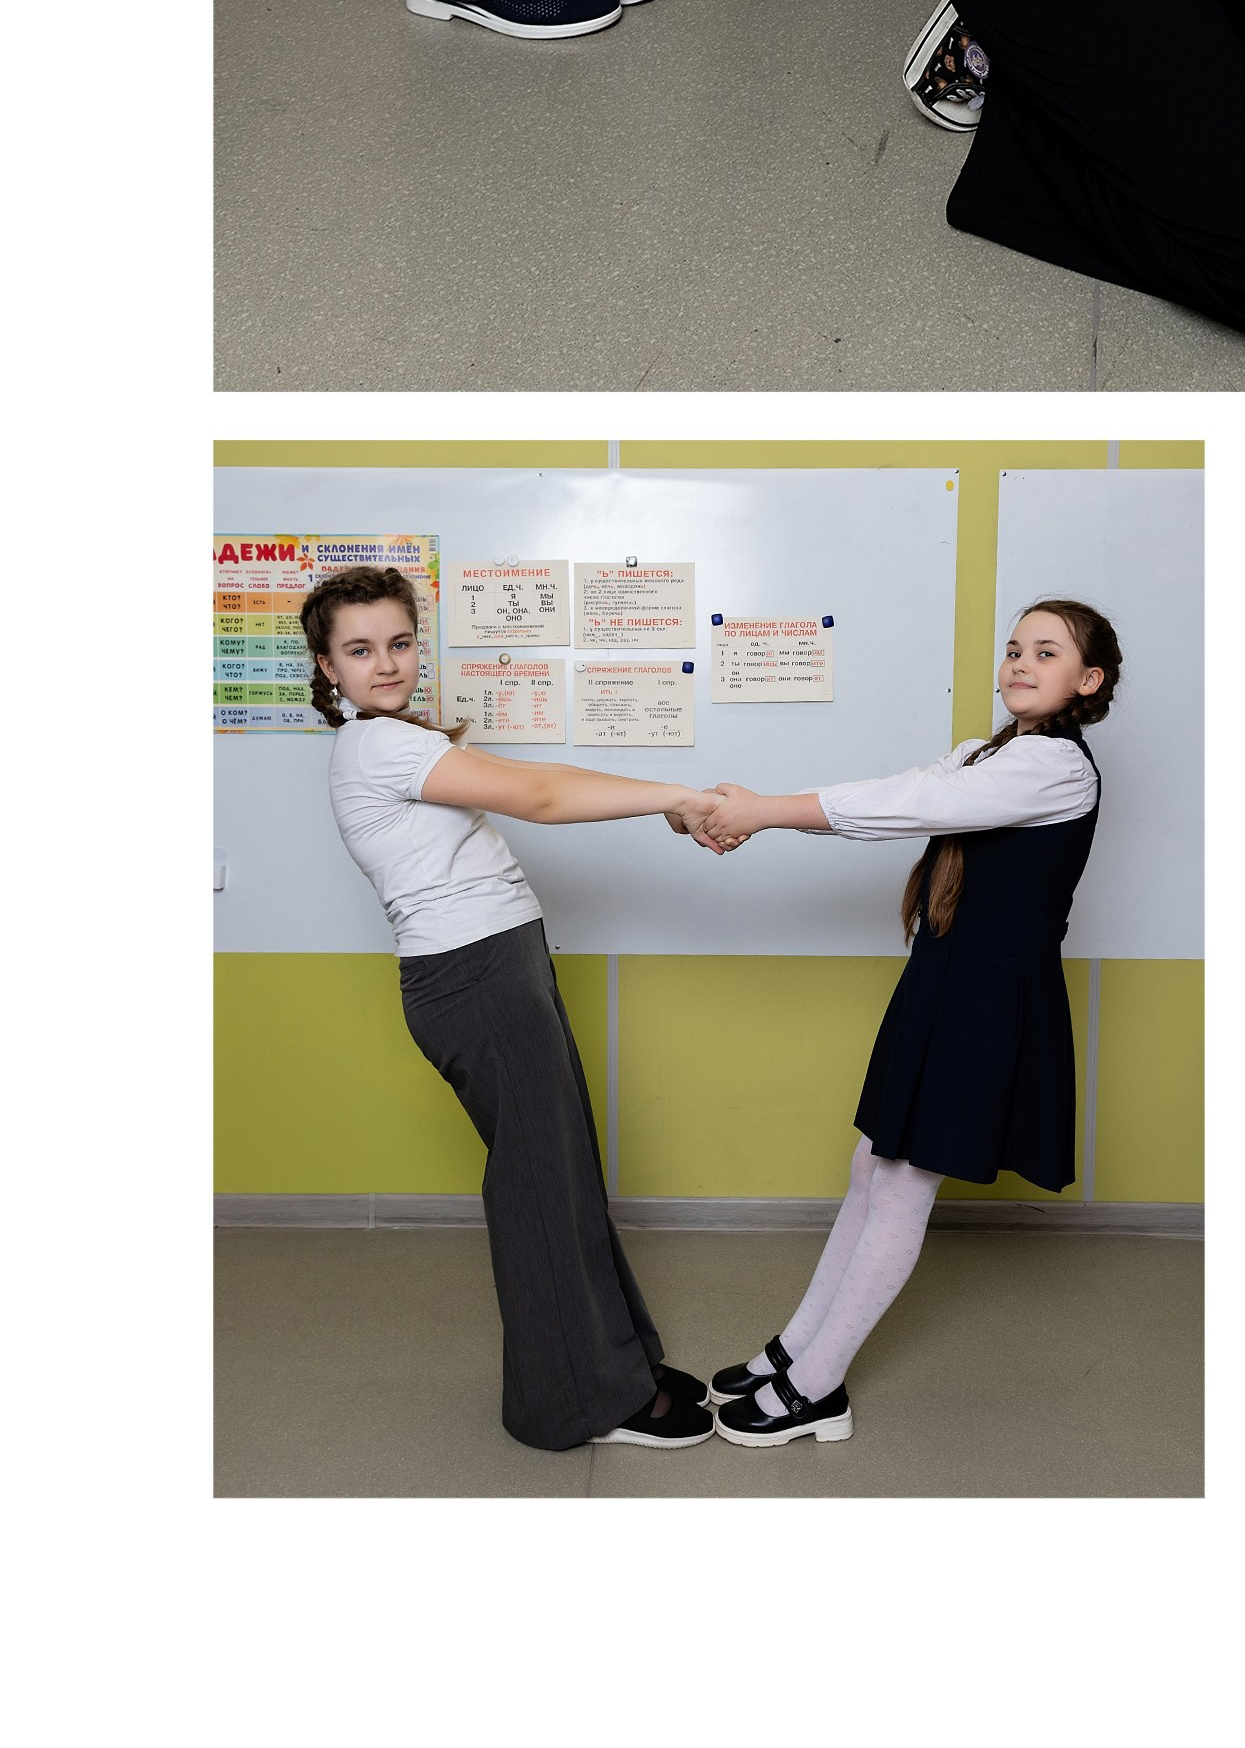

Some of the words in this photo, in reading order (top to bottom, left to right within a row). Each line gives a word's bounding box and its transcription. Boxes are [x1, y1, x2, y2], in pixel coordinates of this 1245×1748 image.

[302, 544, 309, 553] И
[317, 544, 384, 553] СКЛОНЕНИЯ
[388, 542, 420, 554] ИМЁН
[318, 554, 420, 562] СУЩЕСТВИТЕЛЬНЫХ
[463, 568, 550, 578] МЕСТОИМЕНИЕ
[618, 570, 674, 578] ПИШЕТСЯ:
[502, 584, 524, 592] ЕД.Ч.
[610, 618, 624, 626] НЕ
[628, 618, 682, 626] ПИШЕТСЯ:
[724, 622, 777, 630] ИЗМЕНЕНИЕ
[739, 630, 771, 638] ЛИЦАМ
[460, 670, 512, 678] НАСТОЯЩЕГО
